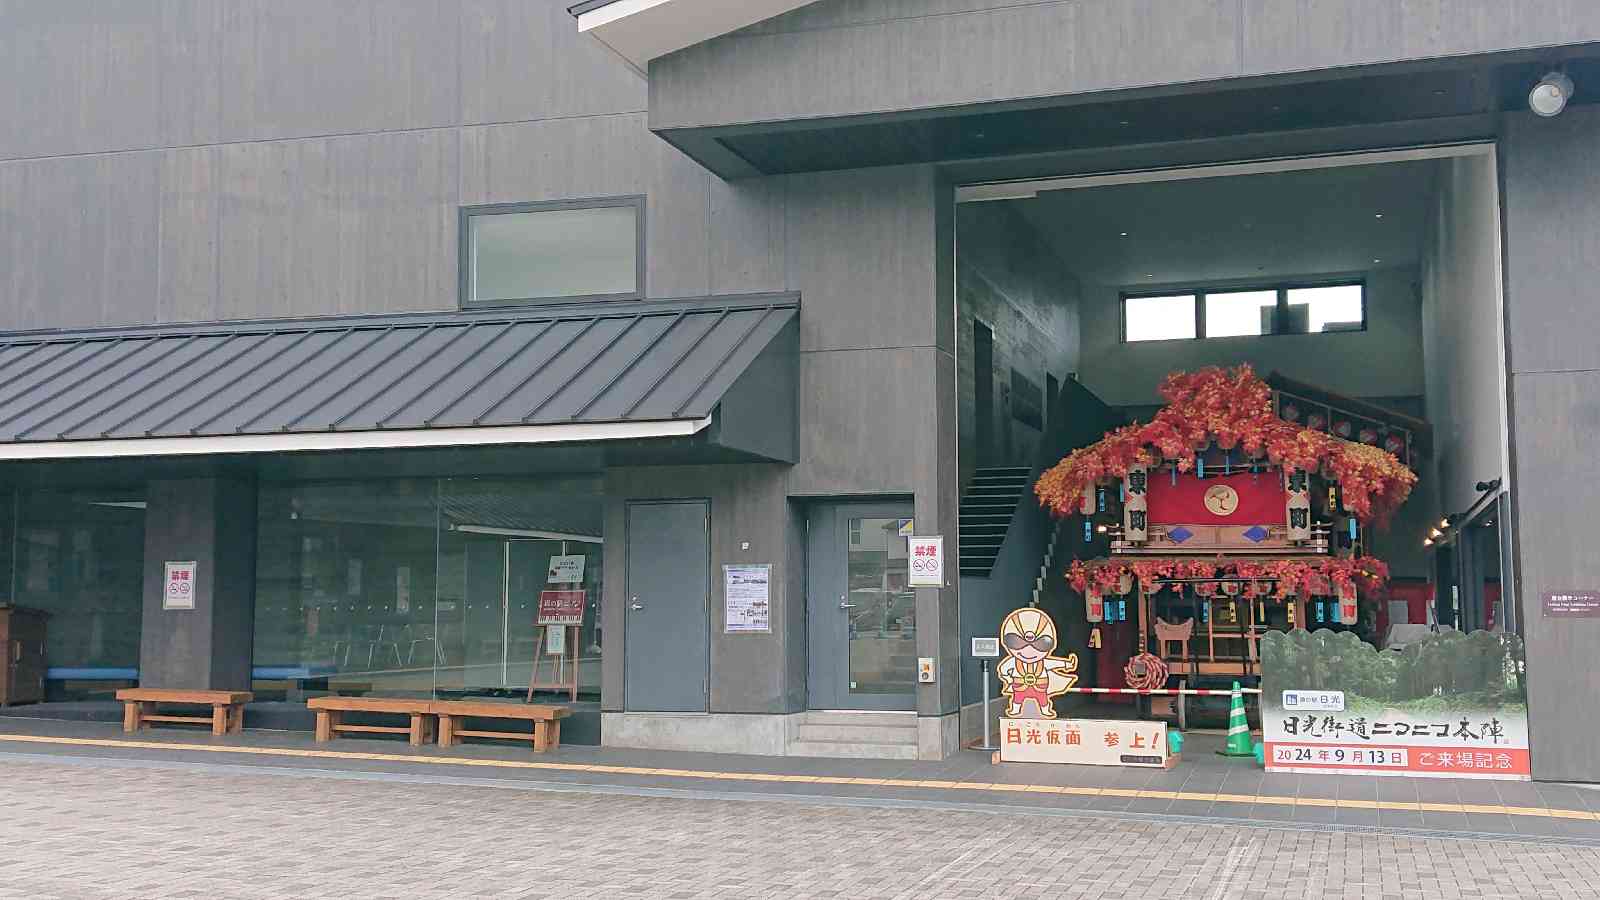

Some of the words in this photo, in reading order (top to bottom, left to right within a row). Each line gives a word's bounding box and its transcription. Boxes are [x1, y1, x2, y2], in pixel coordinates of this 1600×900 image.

[914, 545, 937, 557] 禁煙
[1007, 727, 1081, 746] 日光仮面
[1283, 715, 1504, 744] 日光街道ニコニコ本陣
[1419, 751, 1513, 769] ご来場記念
